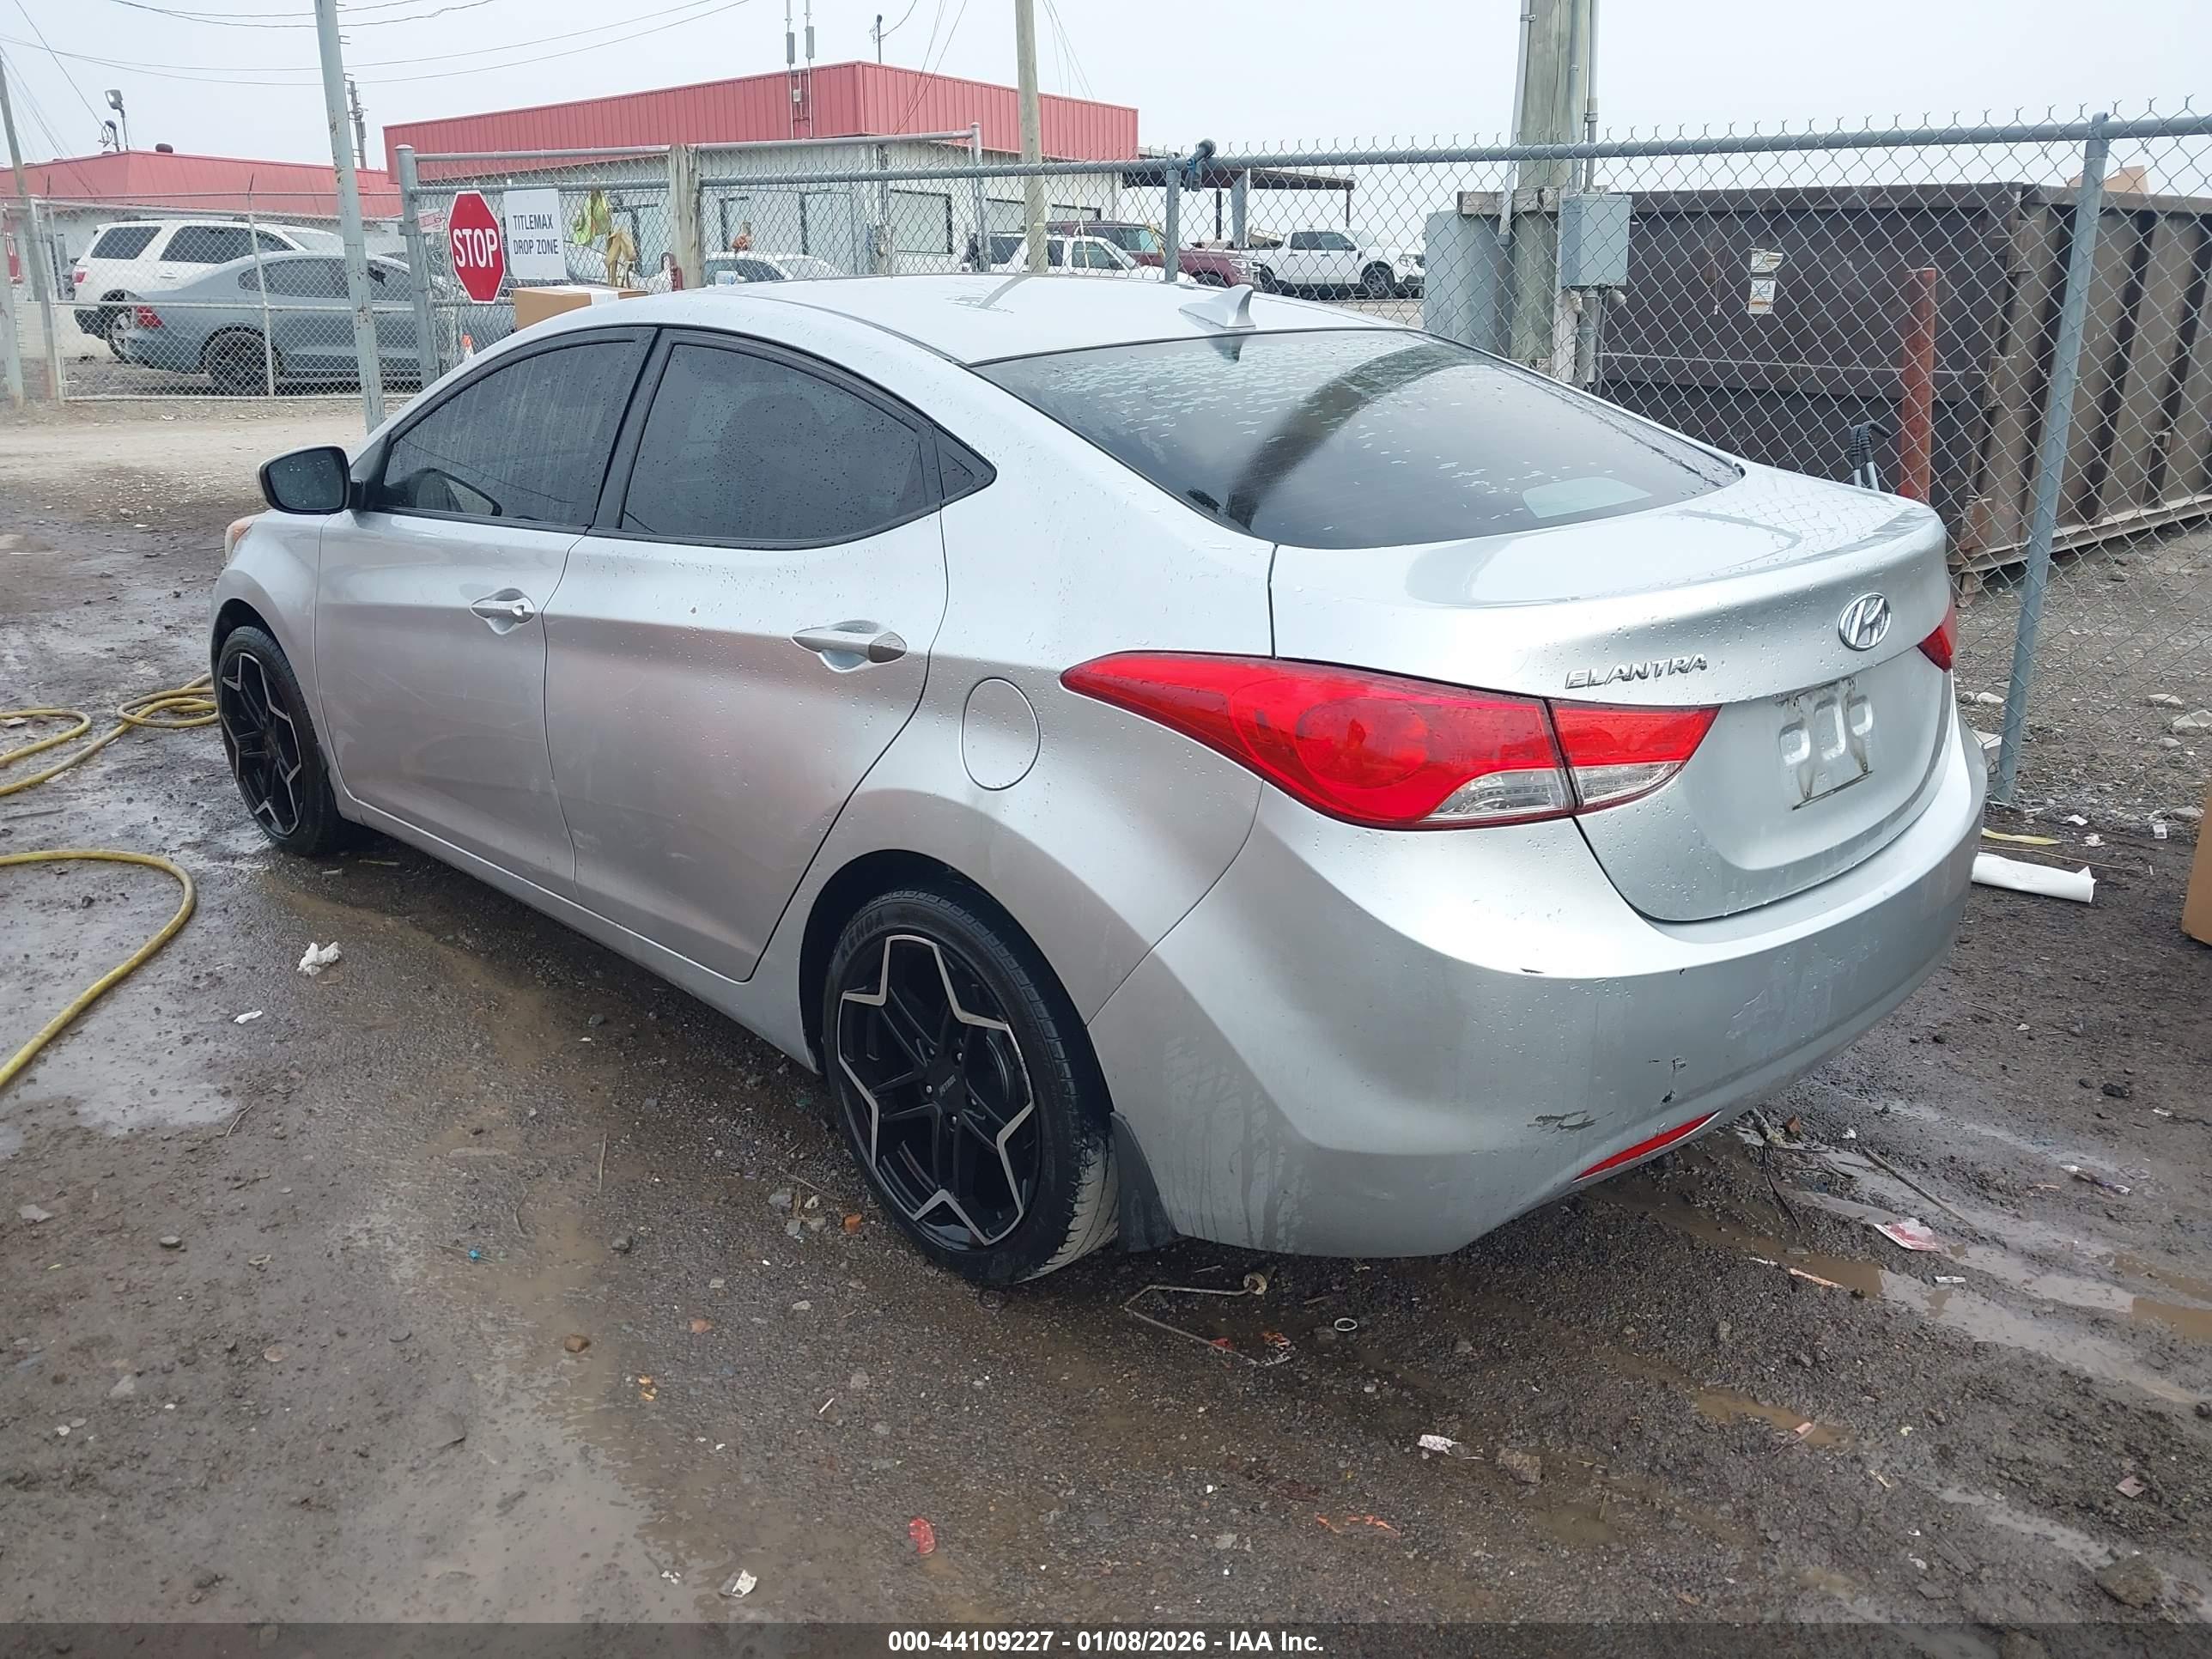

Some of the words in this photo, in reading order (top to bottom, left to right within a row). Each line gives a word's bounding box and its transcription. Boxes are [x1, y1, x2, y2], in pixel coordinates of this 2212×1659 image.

[513, 214, 554, 231] TITLEMAX
[453, 228, 498, 268] STOP
[514, 239, 534, 255] DROP
[537, 238, 559, 255] ZONE
[1565, 653, 1708, 690] ELANTRA
